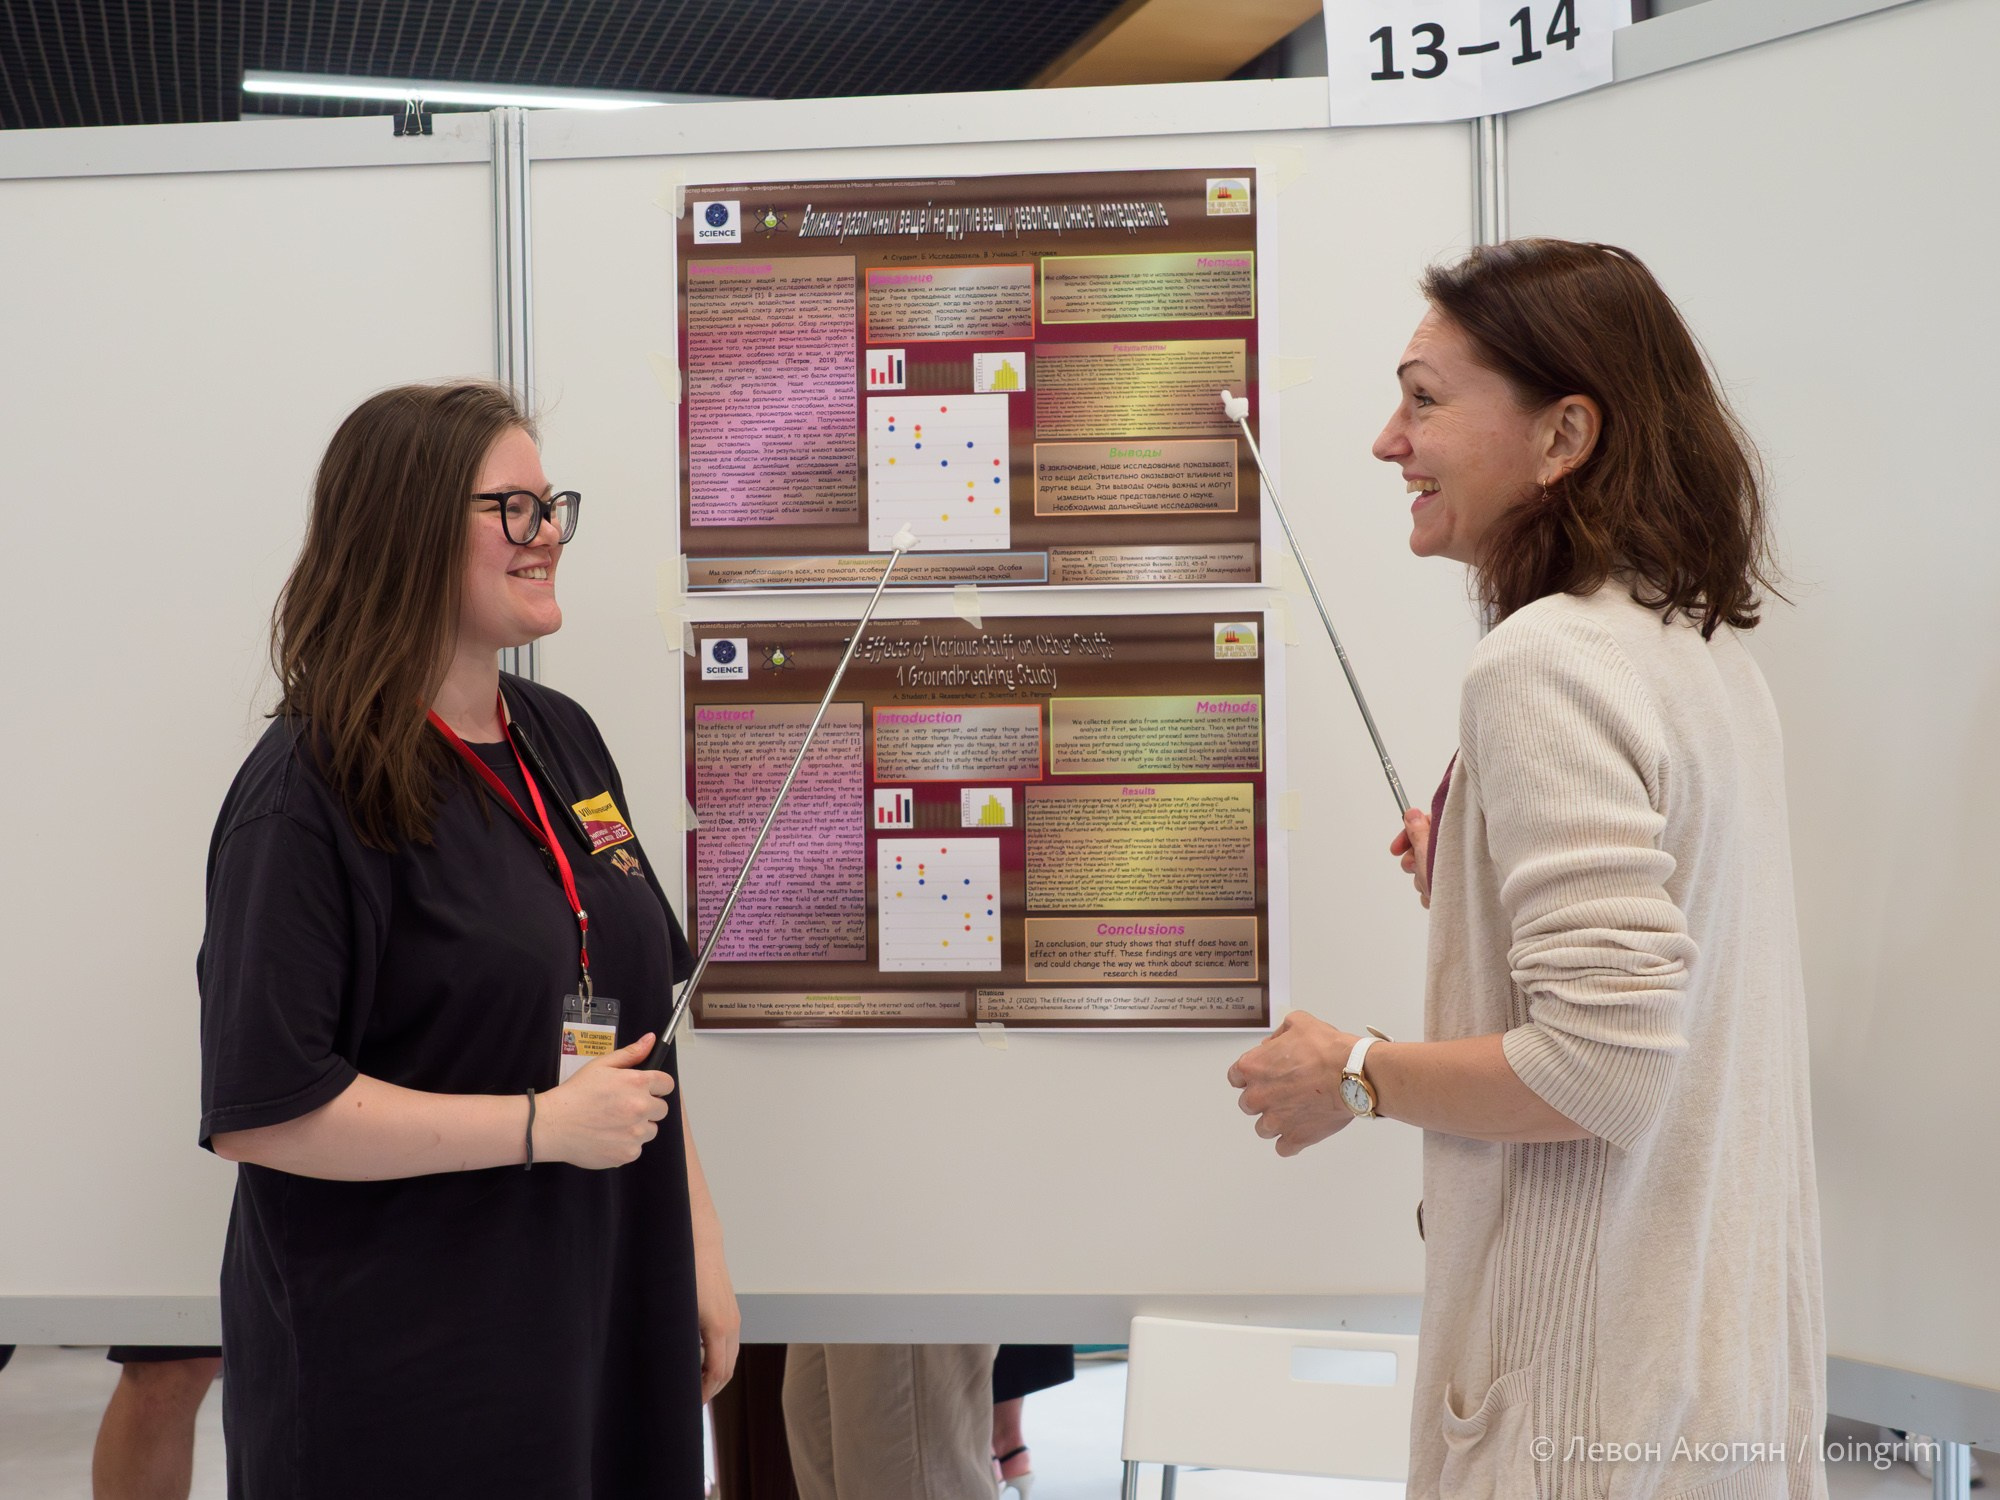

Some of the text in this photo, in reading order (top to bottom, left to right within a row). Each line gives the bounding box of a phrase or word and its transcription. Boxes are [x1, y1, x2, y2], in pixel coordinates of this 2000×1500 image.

[799, 204, 842, 236] Влияние
[933, 208, 945, 232] на
[1109, 448, 1162, 458] Выводы
[1039, 462, 1046, 471] В
[1047, 464, 1099, 473] заключение,
[1122, 462, 1180, 472] исследование
[1182, 462, 1232, 471] показывает,
[1054, 473, 1076, 482] вещи
[1077, 470, 1138, 482] действительно
[1039, 484, 1068, 493] другие
[1095, 481, 1110, 490] Эти
[1112, 483, 1144, 492] выводы
[1207, 481, 1232, 490] могут
[1119, 492, 1181, 502] представление
[1052, 502, 1106, 513] Необходимы
[1107, 501, 1159, 512] дальнейшие
[864, 636, 910, 663] Effects
[914, 636, 928, 662] of
[931, 636, 978, 658] Various
[982, 634, 1016, 661] Stuff
[1018, 640, 1033, 654] on
[1036, 634, 1072, 655] Other
[908, 664, 1015, 690] Groundbreaking
[1017, 663, 1058, 689] Study
[1197, 701, 1257, 713] Methods
[698, 708, 755, 720] Abstract
[877, 712, 962, 724] Introduction
[931, 726, 962, 734] important,
[1001, 725, 1020, 733] things
[1122, 787, 1155, 796] Results
[1098, 923, 1185, 935] Conclusions
[1034, 939, 1044, 948] In
[1045, 939, 1088, 950] conclusion,
[1105, 939, 1127, 949] study
[1129, 938, 1153, 947] shows
[1155, 938, 1172, 947] that
[1174, 938, 1195, 947] stuff
[1197, 938, 1216, 947] does
[1218, 938, 1237, 947] have
[1029, 949, 1055, 958] effect
[1069, 949, 1091, 957] other
[1119, 948, 1143, 957] These
[1145, 948, 1177, 959] findings
[1194, 950, 1211, 959] very
[1214, 948, 1253, 959] important
[1033, 959, 1048, 968] and
[1049, 959, 1071, 968] could
[1072, 959, 1100, 969] change
[1102, 959, 1116, 967] the
[1117, 960, 1132, 969] way
[1147, 958, 1168, 967] think
[1170, 958, 1192, 967] about
[1227, 958, 1249, 967] More
[1103, 968, 1138, 977] research
[938, 1001, 960, 1009] Special
